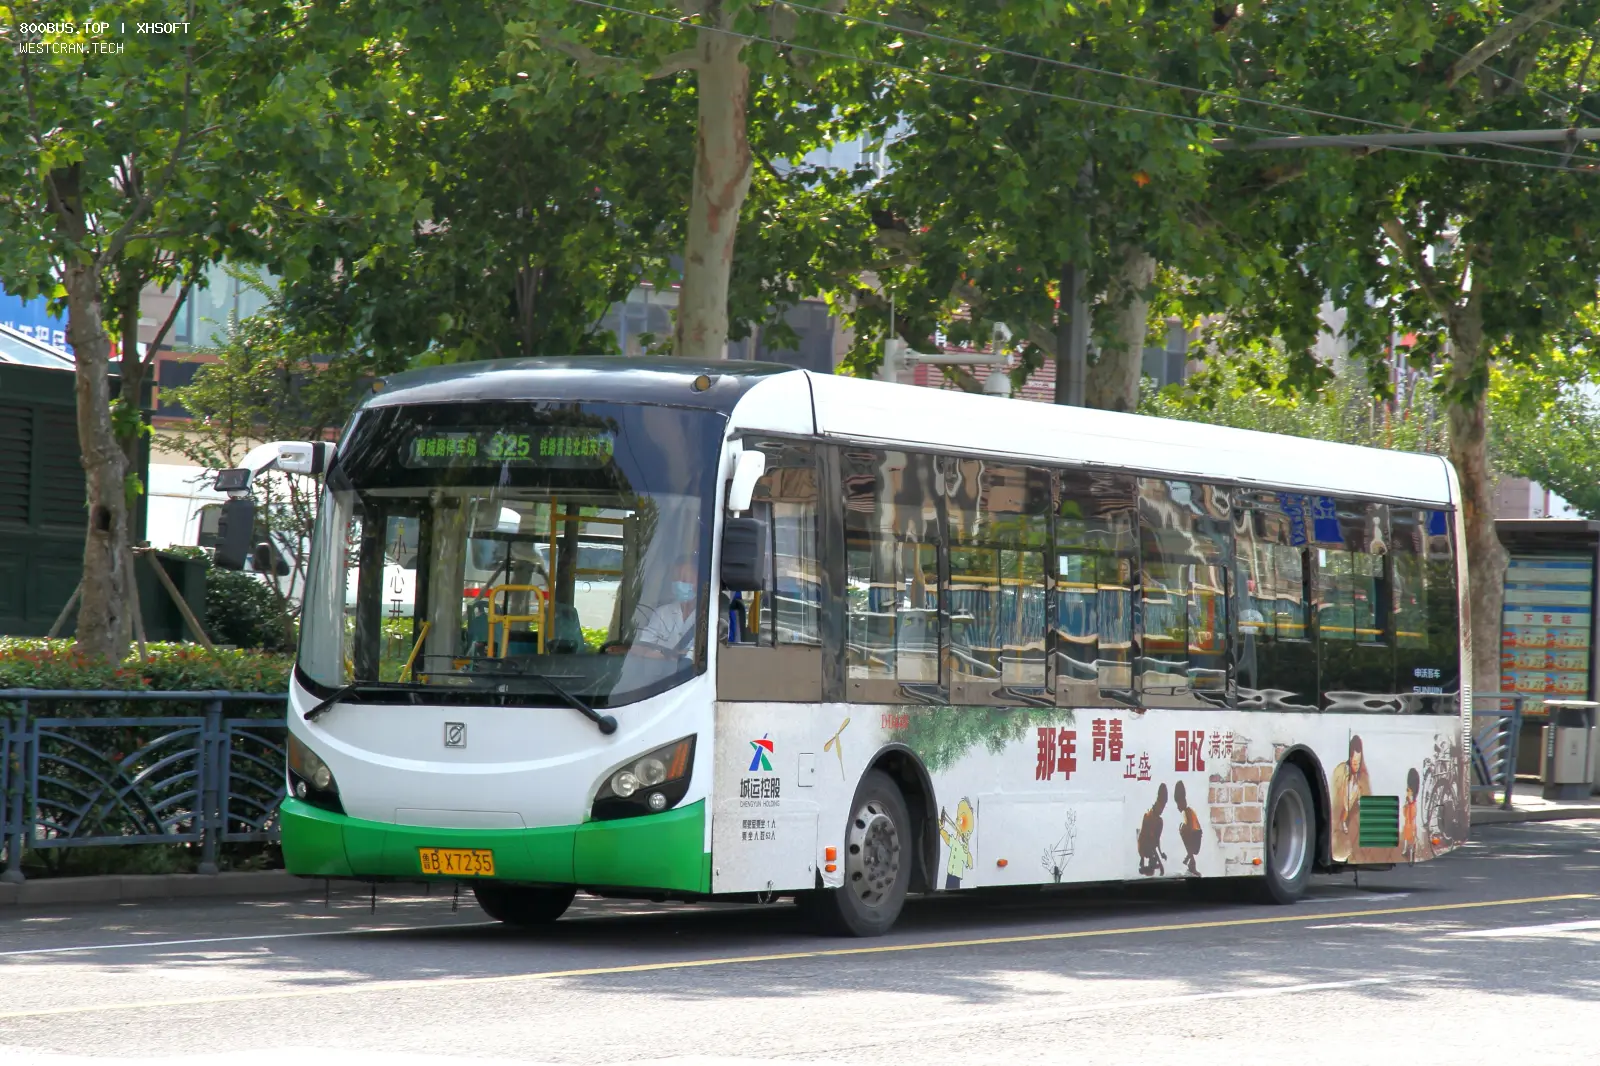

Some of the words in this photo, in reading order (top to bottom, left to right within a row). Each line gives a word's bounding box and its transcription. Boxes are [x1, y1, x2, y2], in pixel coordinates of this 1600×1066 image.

[491, 434, 530, 457] 325
[1412, 685, 1443, 695] SUNWIN
[1036, 726, 1077, 781] 那年
[1091, 717, 1123, 762] 青春
[1123, 751, 1152, 781] 正盛
[1174, 730, 1206, 772] 回忆
[1208, 730, 1234, 759] 满满
[740, 777, 781, 799] 城运控股
[740, 799, 762, 808] CHENGYUN
[763, 799, 780, 807] HOLDING
